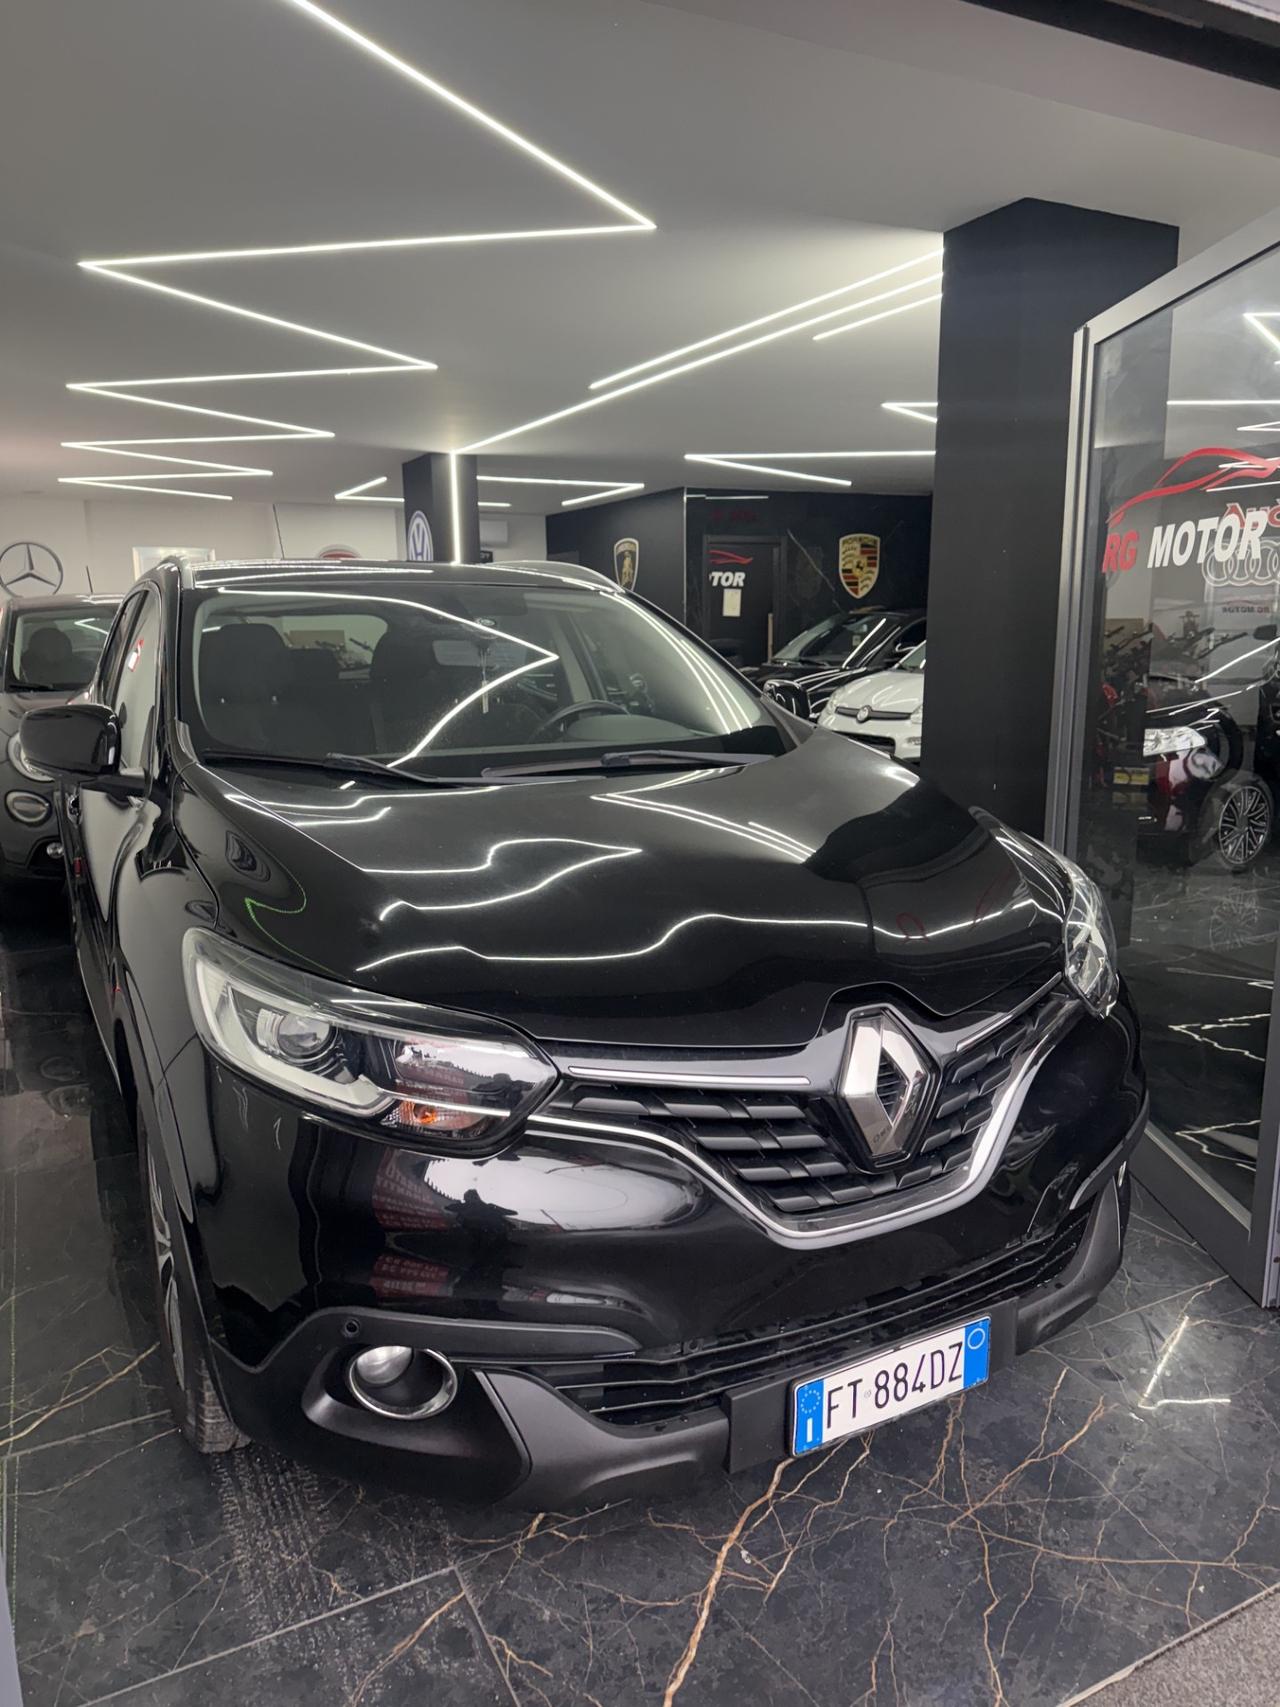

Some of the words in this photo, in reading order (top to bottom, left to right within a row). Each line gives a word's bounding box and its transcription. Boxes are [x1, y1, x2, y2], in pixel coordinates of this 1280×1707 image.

[1101, 532, 1139, 573] RG
[1147, 511, 1269, 569] MOTOR
[709, 571, 746, 587] TOR
[826, 1379, 863, 1429] FT
[874, 1341, 964, 1410] 884DZ
[806, 1417, 814, 1443] I
